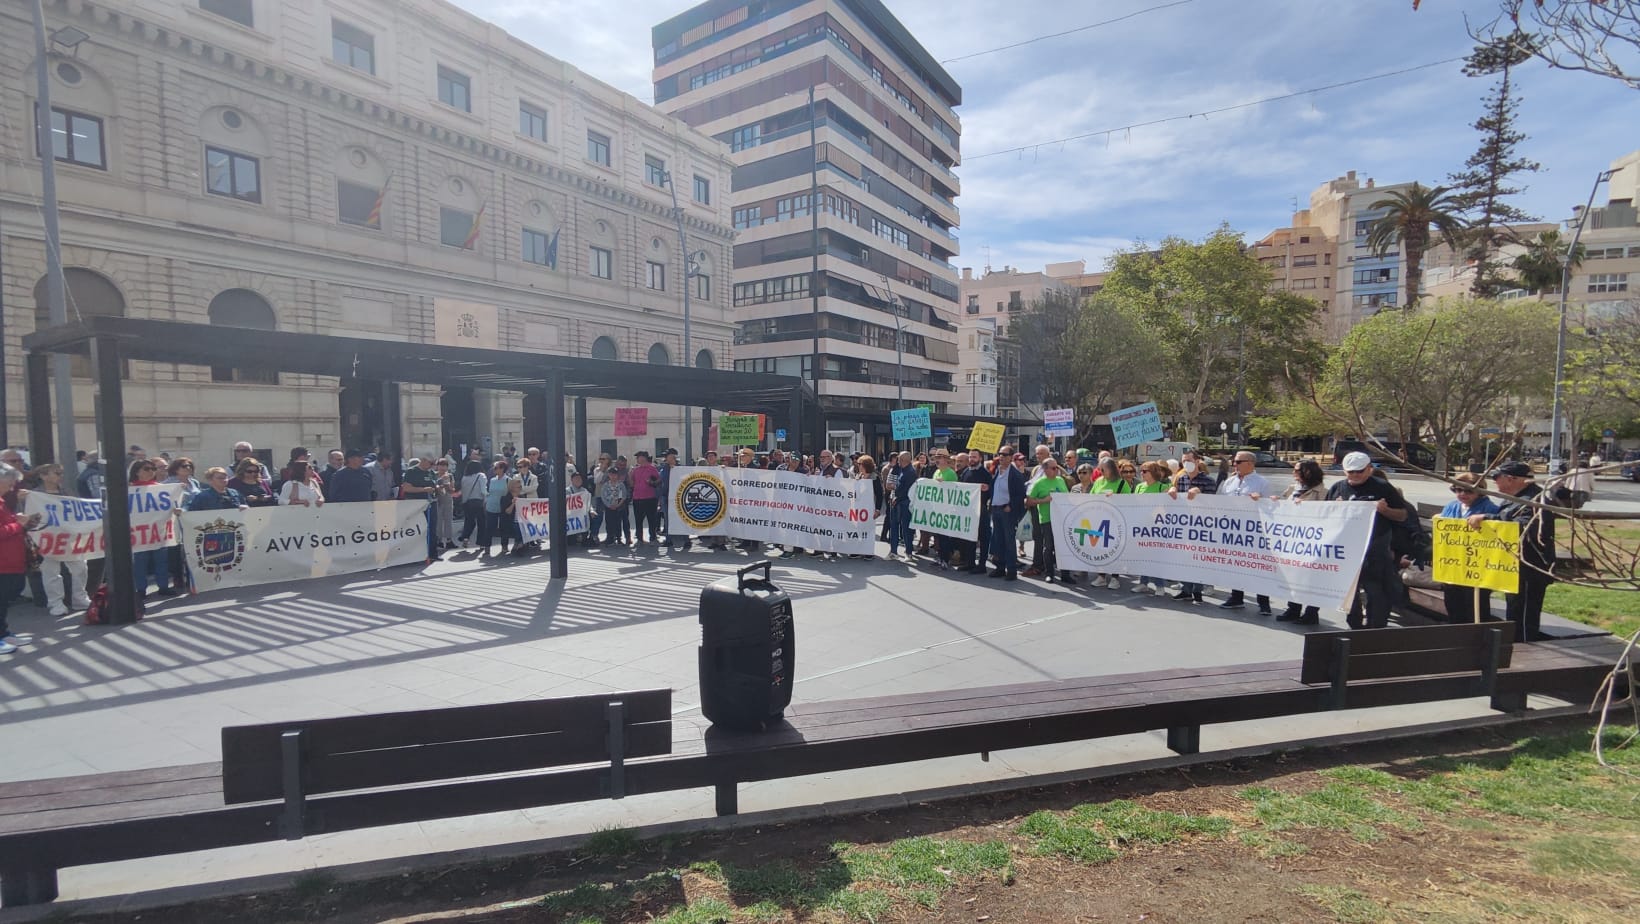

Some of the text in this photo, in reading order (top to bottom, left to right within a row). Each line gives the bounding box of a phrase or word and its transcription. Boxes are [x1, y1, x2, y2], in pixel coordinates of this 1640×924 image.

[916, 484, 944, 504] UERA
[730, 516, 769, 527] VARIANTE
[849, 508, 868, 522] NO
[929, 511, 961, 532] COSTA
[1154, 513, 1324, 540] ASOCIACIÓN DE VECINOS
[39, 532, 71, 556] DE
[72, 530, 95, 555] LA
[266, 524, 422, 553] AVV San Gabriel
[1132, 526, 1346, 560] PARQUE DEL MAR DE ALICANTE
[1218, 548, 1246, 558] MEJORA
[1248, 552, 1259, 560] DEL
[1302, 562, 1340, 572] ALICANTE
[1227, 558, 1233, 566] A
[1440, 557, 1461, 568] por
[1466, 557, 1480, 568] la
